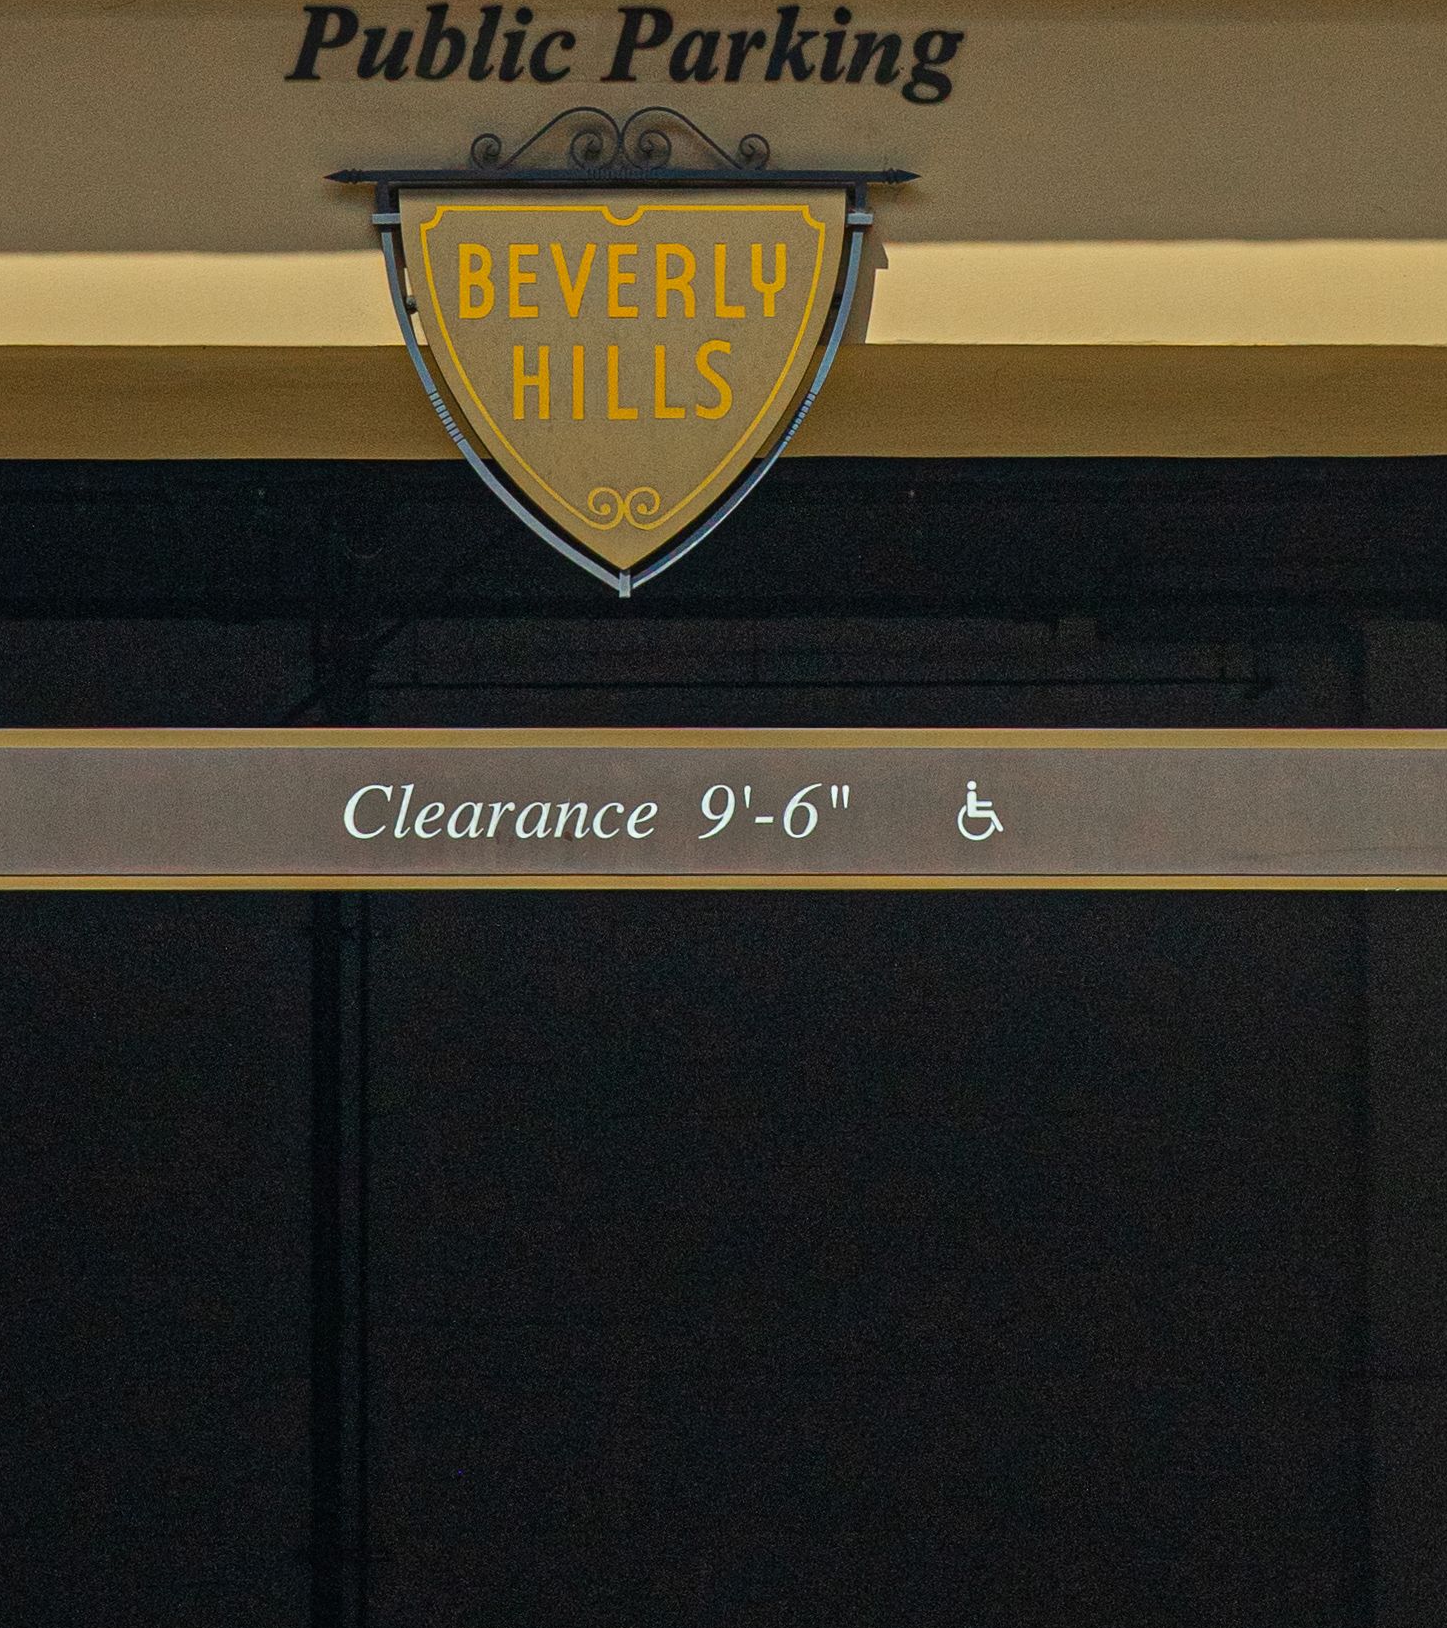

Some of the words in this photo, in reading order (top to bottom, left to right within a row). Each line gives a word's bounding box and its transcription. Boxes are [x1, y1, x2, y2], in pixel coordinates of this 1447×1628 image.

[285, 3, 577, 82] Public
[600, 4, 965, 105] Parking
[458, 242, 787, 319] BEVERLY
[512, 340, 733, 421] HILLS
[343, 783, 658, 839] Clearance
[698, 783, 851, 840] 9'-6"
